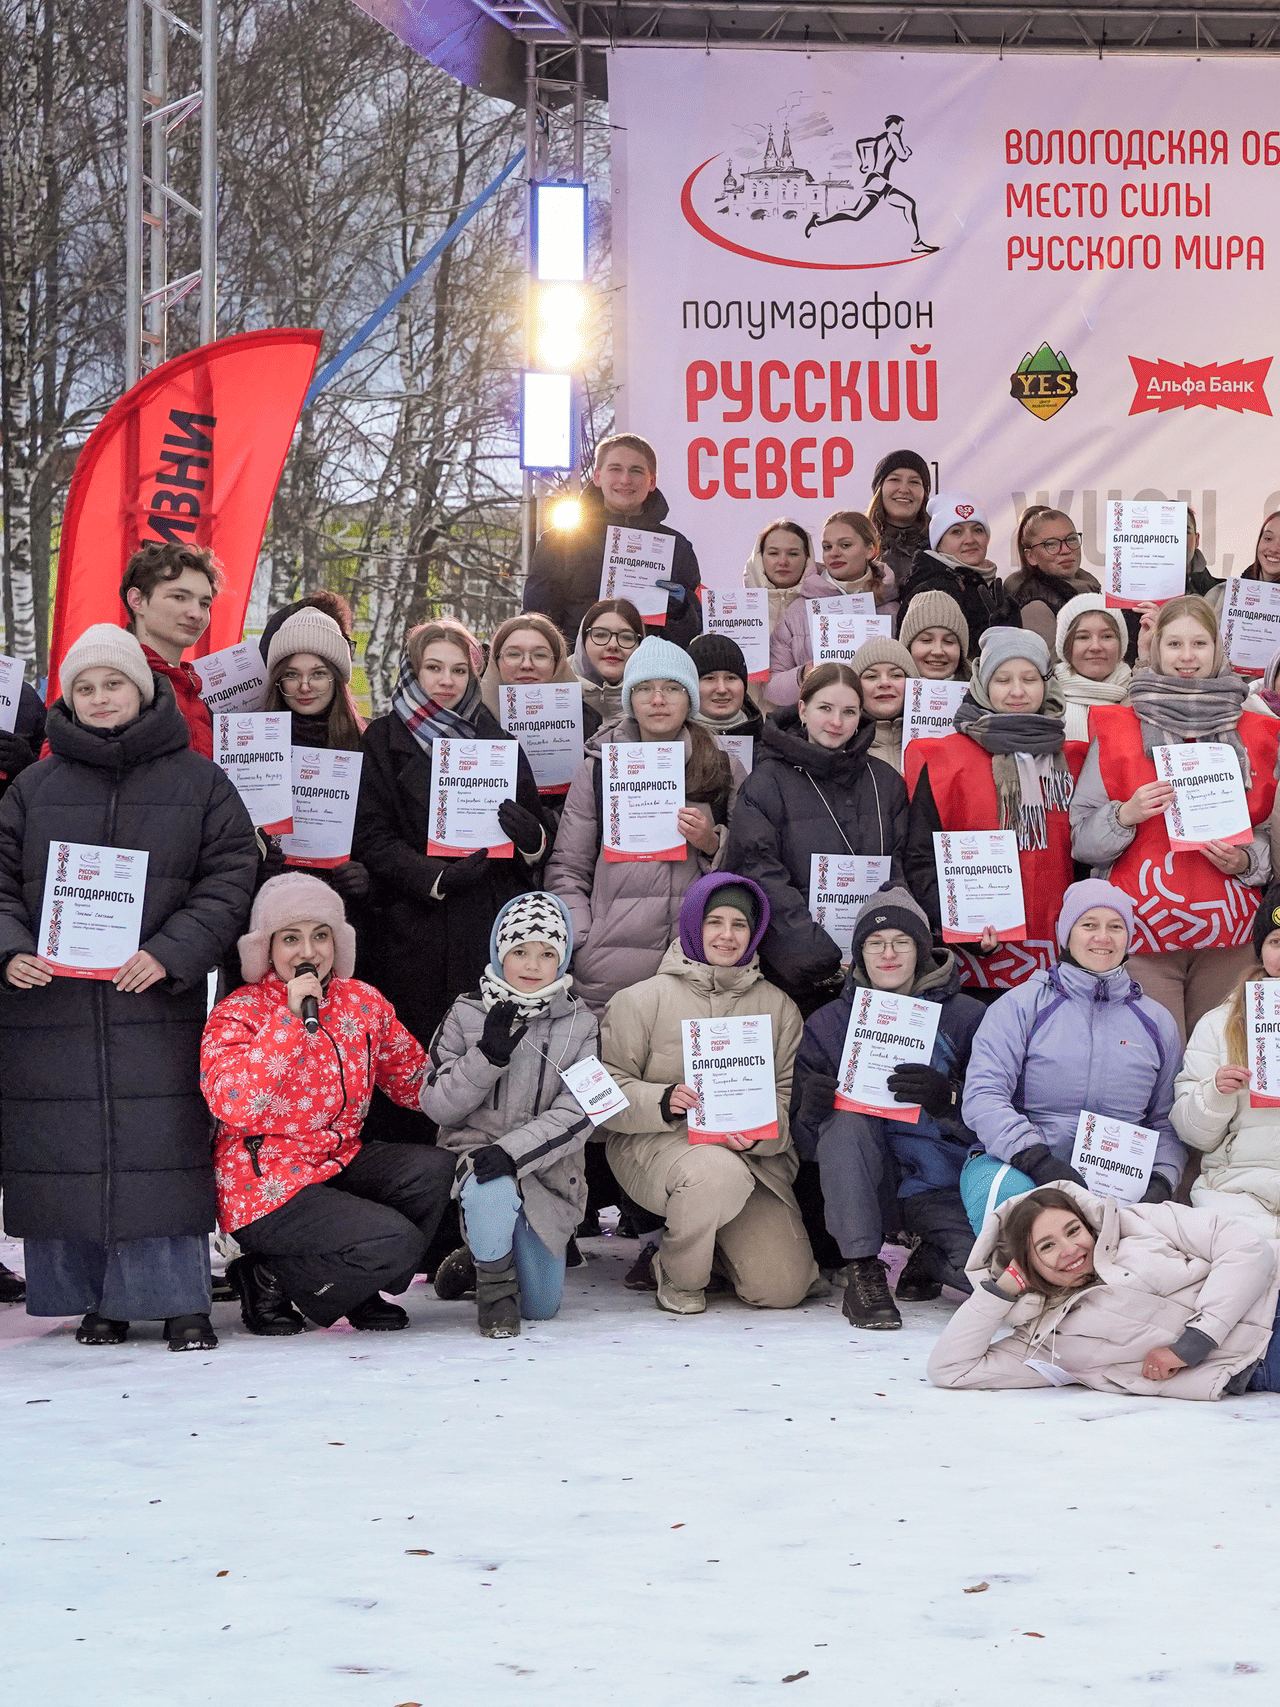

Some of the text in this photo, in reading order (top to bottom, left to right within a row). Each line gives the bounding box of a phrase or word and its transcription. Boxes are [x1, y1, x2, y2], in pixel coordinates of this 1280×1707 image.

[1005, 129, 1228, 170] ВОЛОГОДСКАЯ
[1006, 182, 1211, 218] МЕСТО СИЛЫ
[1007, 234, 1264, 271] РУССКОГО МИРА
[683, 291, 933, 340] полумарафон
[686, 344, 938, 423] РУССКИЙ
[1146, 376, 1255, 398] Альфа Банк
[687, 436, 854, 500] СЕВЕР
[1113, 533, 1179, 544] БЛАГОДАРНОСТЬ
[610, 556, 666, 570] БЛАГОДАРНОСТЬ
[708, 617, 763, 628] БЛАГОДАРНОСТЬ
[203, 677, 262, 705] ЛАГОДАРНОСТЬ
[508, 720, 576, 731] БЛАГОДАРНОСТЬ
[911, 716, 953, 726] БЛАГОДАР
[220, 752, 283, 764] БЛАГОДАРНОСТЬ
[439, 777, 509, 788] БЛАГОДАРНОСТЬ
[609, 781, 677, 792] БЛАГОДАРНОСТЬ
[292, 786, 350, 800] АГОДАРНОСТЬ
[944, 864, 1013, 875] БЛАГОДАРНОСТЬ
[53, 886, 135, 904] БЛАГОДАРНОСТЬ
[854, 1027, 925, 1050] БЛАГОДАРНОСТЬ
[692, 1056, 765, 1070] БЛАГОДАРНОСТЬ
[1079, 1152, 1144, 1179] БЛАГОДАРНОСТЬ
